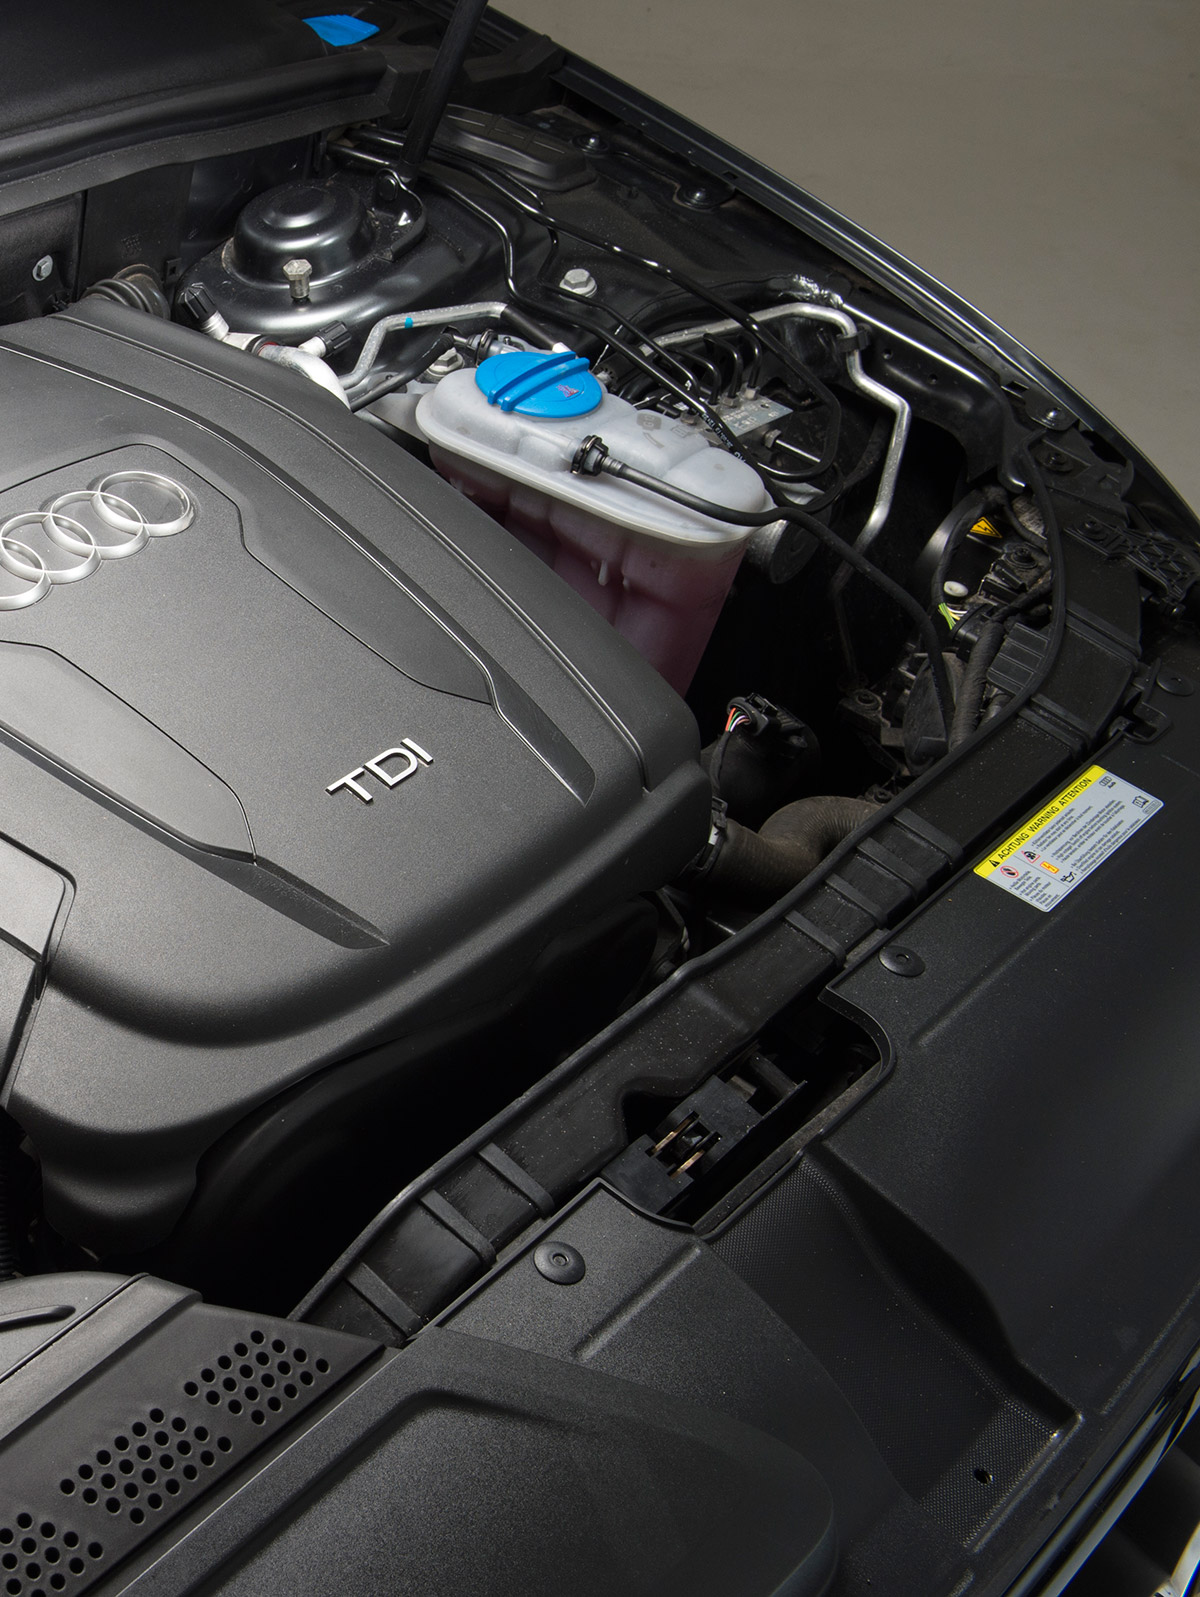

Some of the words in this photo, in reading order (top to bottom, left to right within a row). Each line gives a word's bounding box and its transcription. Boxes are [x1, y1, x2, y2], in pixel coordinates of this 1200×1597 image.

[325, 737, 434, 805] TDI
[997, 832, 1030, 860] ACHTUNG
[1028, 806, 1060, 833] WARNING
[1058, 777, 1093, 807] ATTENTION
